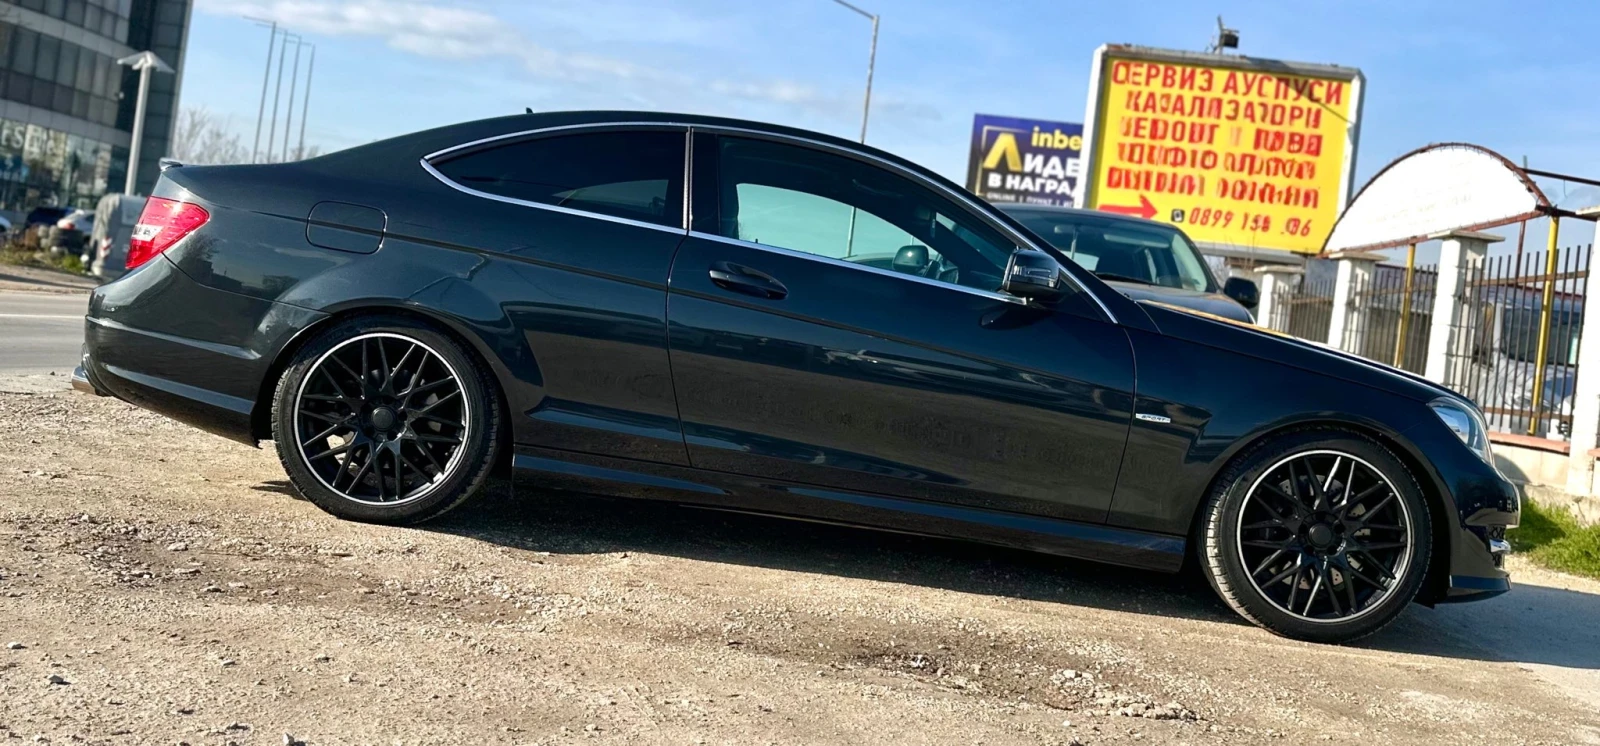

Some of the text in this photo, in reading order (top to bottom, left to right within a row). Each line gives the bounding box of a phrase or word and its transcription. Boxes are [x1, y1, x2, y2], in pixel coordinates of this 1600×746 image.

[1112, 61, 1343, 106] СЕРВИЗ АУСПУСИ
[1189, 206, 1234, 229] 0899
